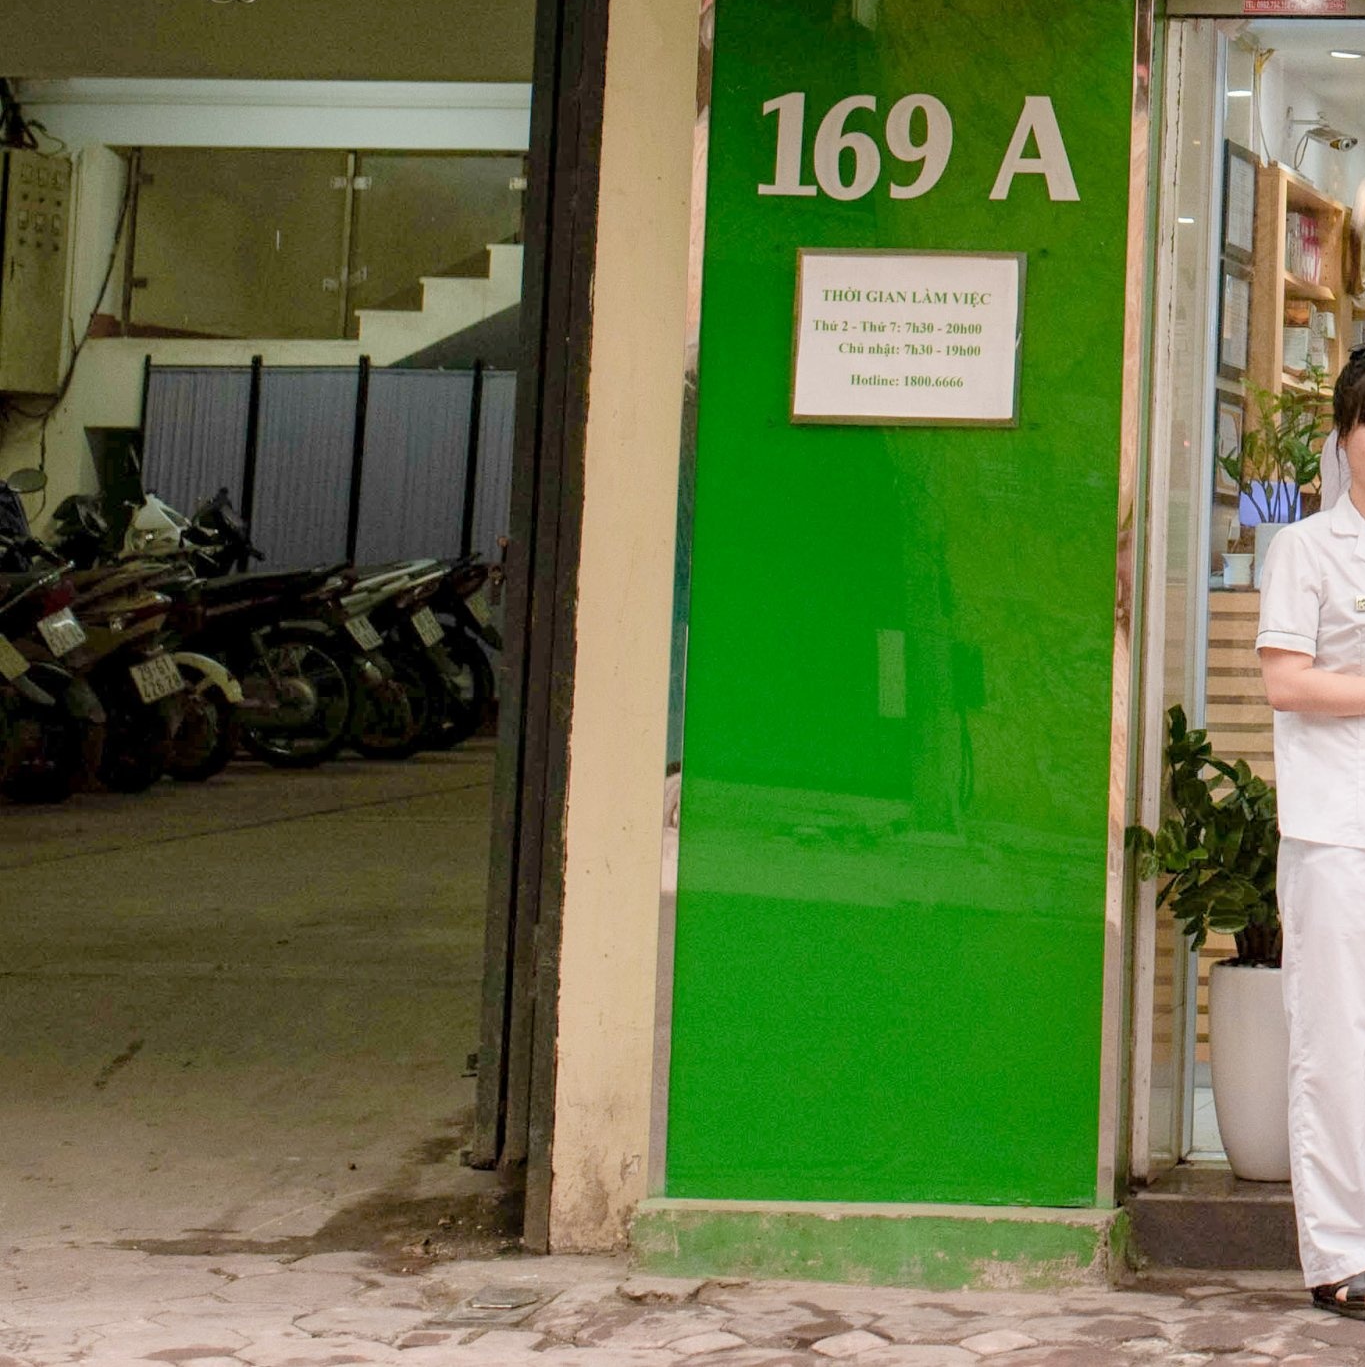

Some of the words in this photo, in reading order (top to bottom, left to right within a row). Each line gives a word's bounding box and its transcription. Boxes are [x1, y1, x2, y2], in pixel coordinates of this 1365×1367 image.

[757, 91, 954, 202] 169
[988, 95, 1081, 202] A
[822, 286, 862, 303] THỜI
[865, 290, 907, 304] GIAN
[911, 288, 948, 305] LÀM
[952, 291, 992, 308] VIỆC
[841, 320, 849, 332] 2
[889, 322, 901, 333] 7:
[905, 322, 935, 334] 7h30
[945, 323, 982, 335] 20h00
[904, 344, 933, 356] 7h30
[946, 345, 981, 357] 19h00
[850, 374, 900, 387] Hotline:
[904, 375, 964, 389] 1800.6666
